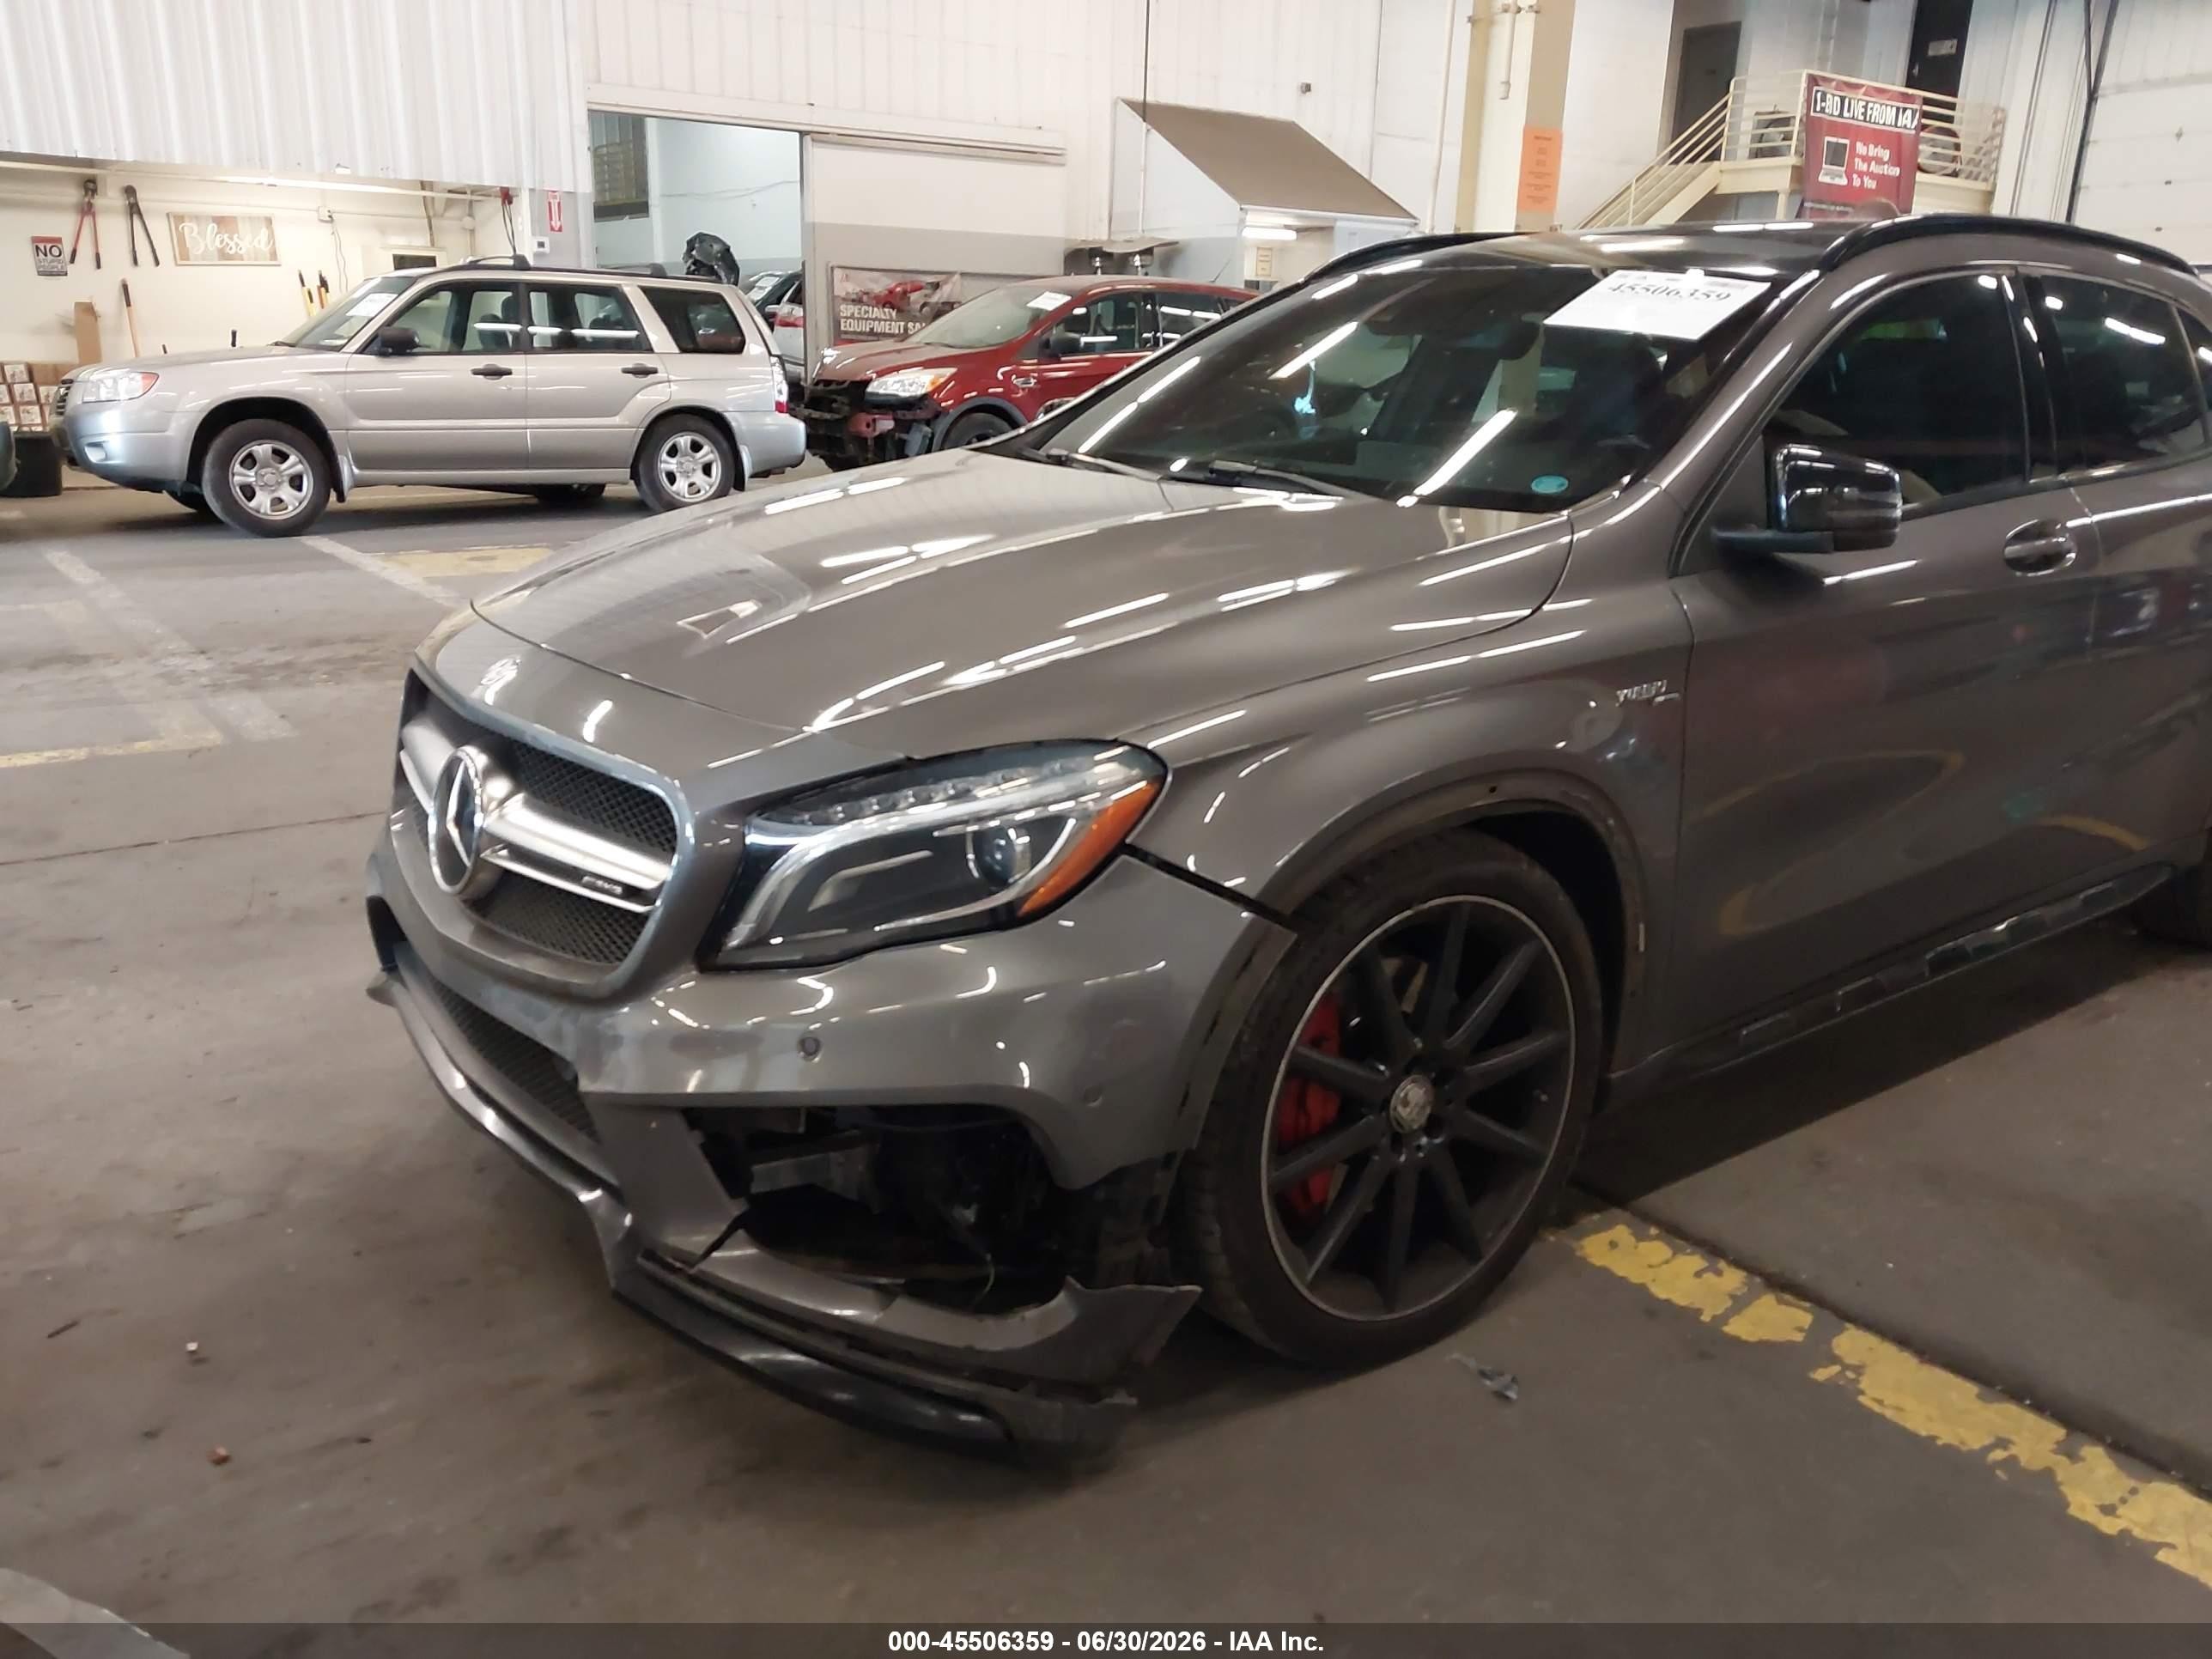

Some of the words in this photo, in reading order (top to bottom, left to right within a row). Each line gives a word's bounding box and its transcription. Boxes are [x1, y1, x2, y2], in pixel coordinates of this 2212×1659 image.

[1843, 98, 1865, 121] LIVE
[1867, 102, 1895, 127] FROM
[1868, 143, 1891, 161] Bring
[1854, 157, 1868, 172] The
[1869, 161, 1900, 177] Auction
[1852, 173, 1862, 187] To
[1863, 175, 1877, 190] You
[179, 222, 273, 255] Blessed
[35, 244, 63, 258] NO
[840, 304, 897, 319] SPECIALTY
[840, 319, 905, 334] EQUIPMENT
